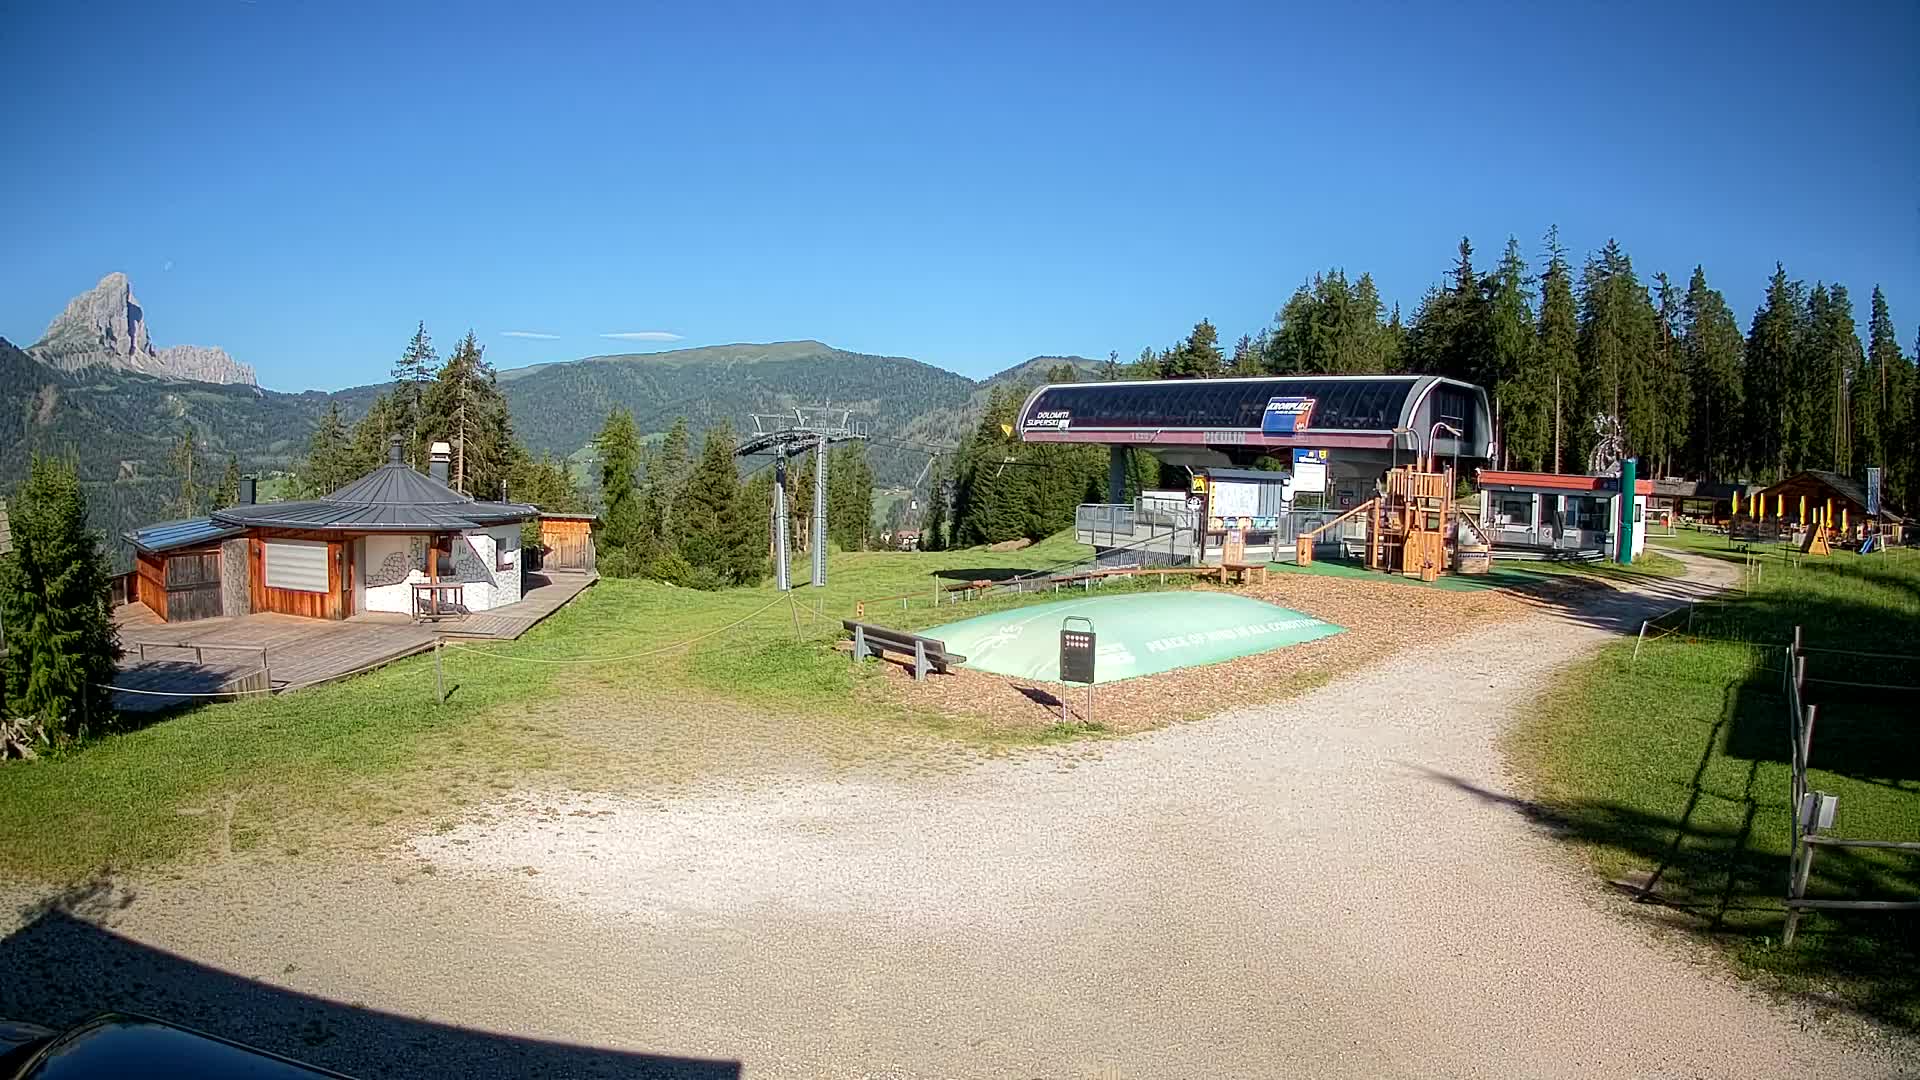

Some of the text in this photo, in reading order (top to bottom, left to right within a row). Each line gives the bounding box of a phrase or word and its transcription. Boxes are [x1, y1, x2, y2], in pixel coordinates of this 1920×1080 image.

[1037, 411, 1069, 419] DOLOMITI
[1026, 419, 1058, 427] SUPERSKI
[1146, 635, 1188, 653] PEACE
